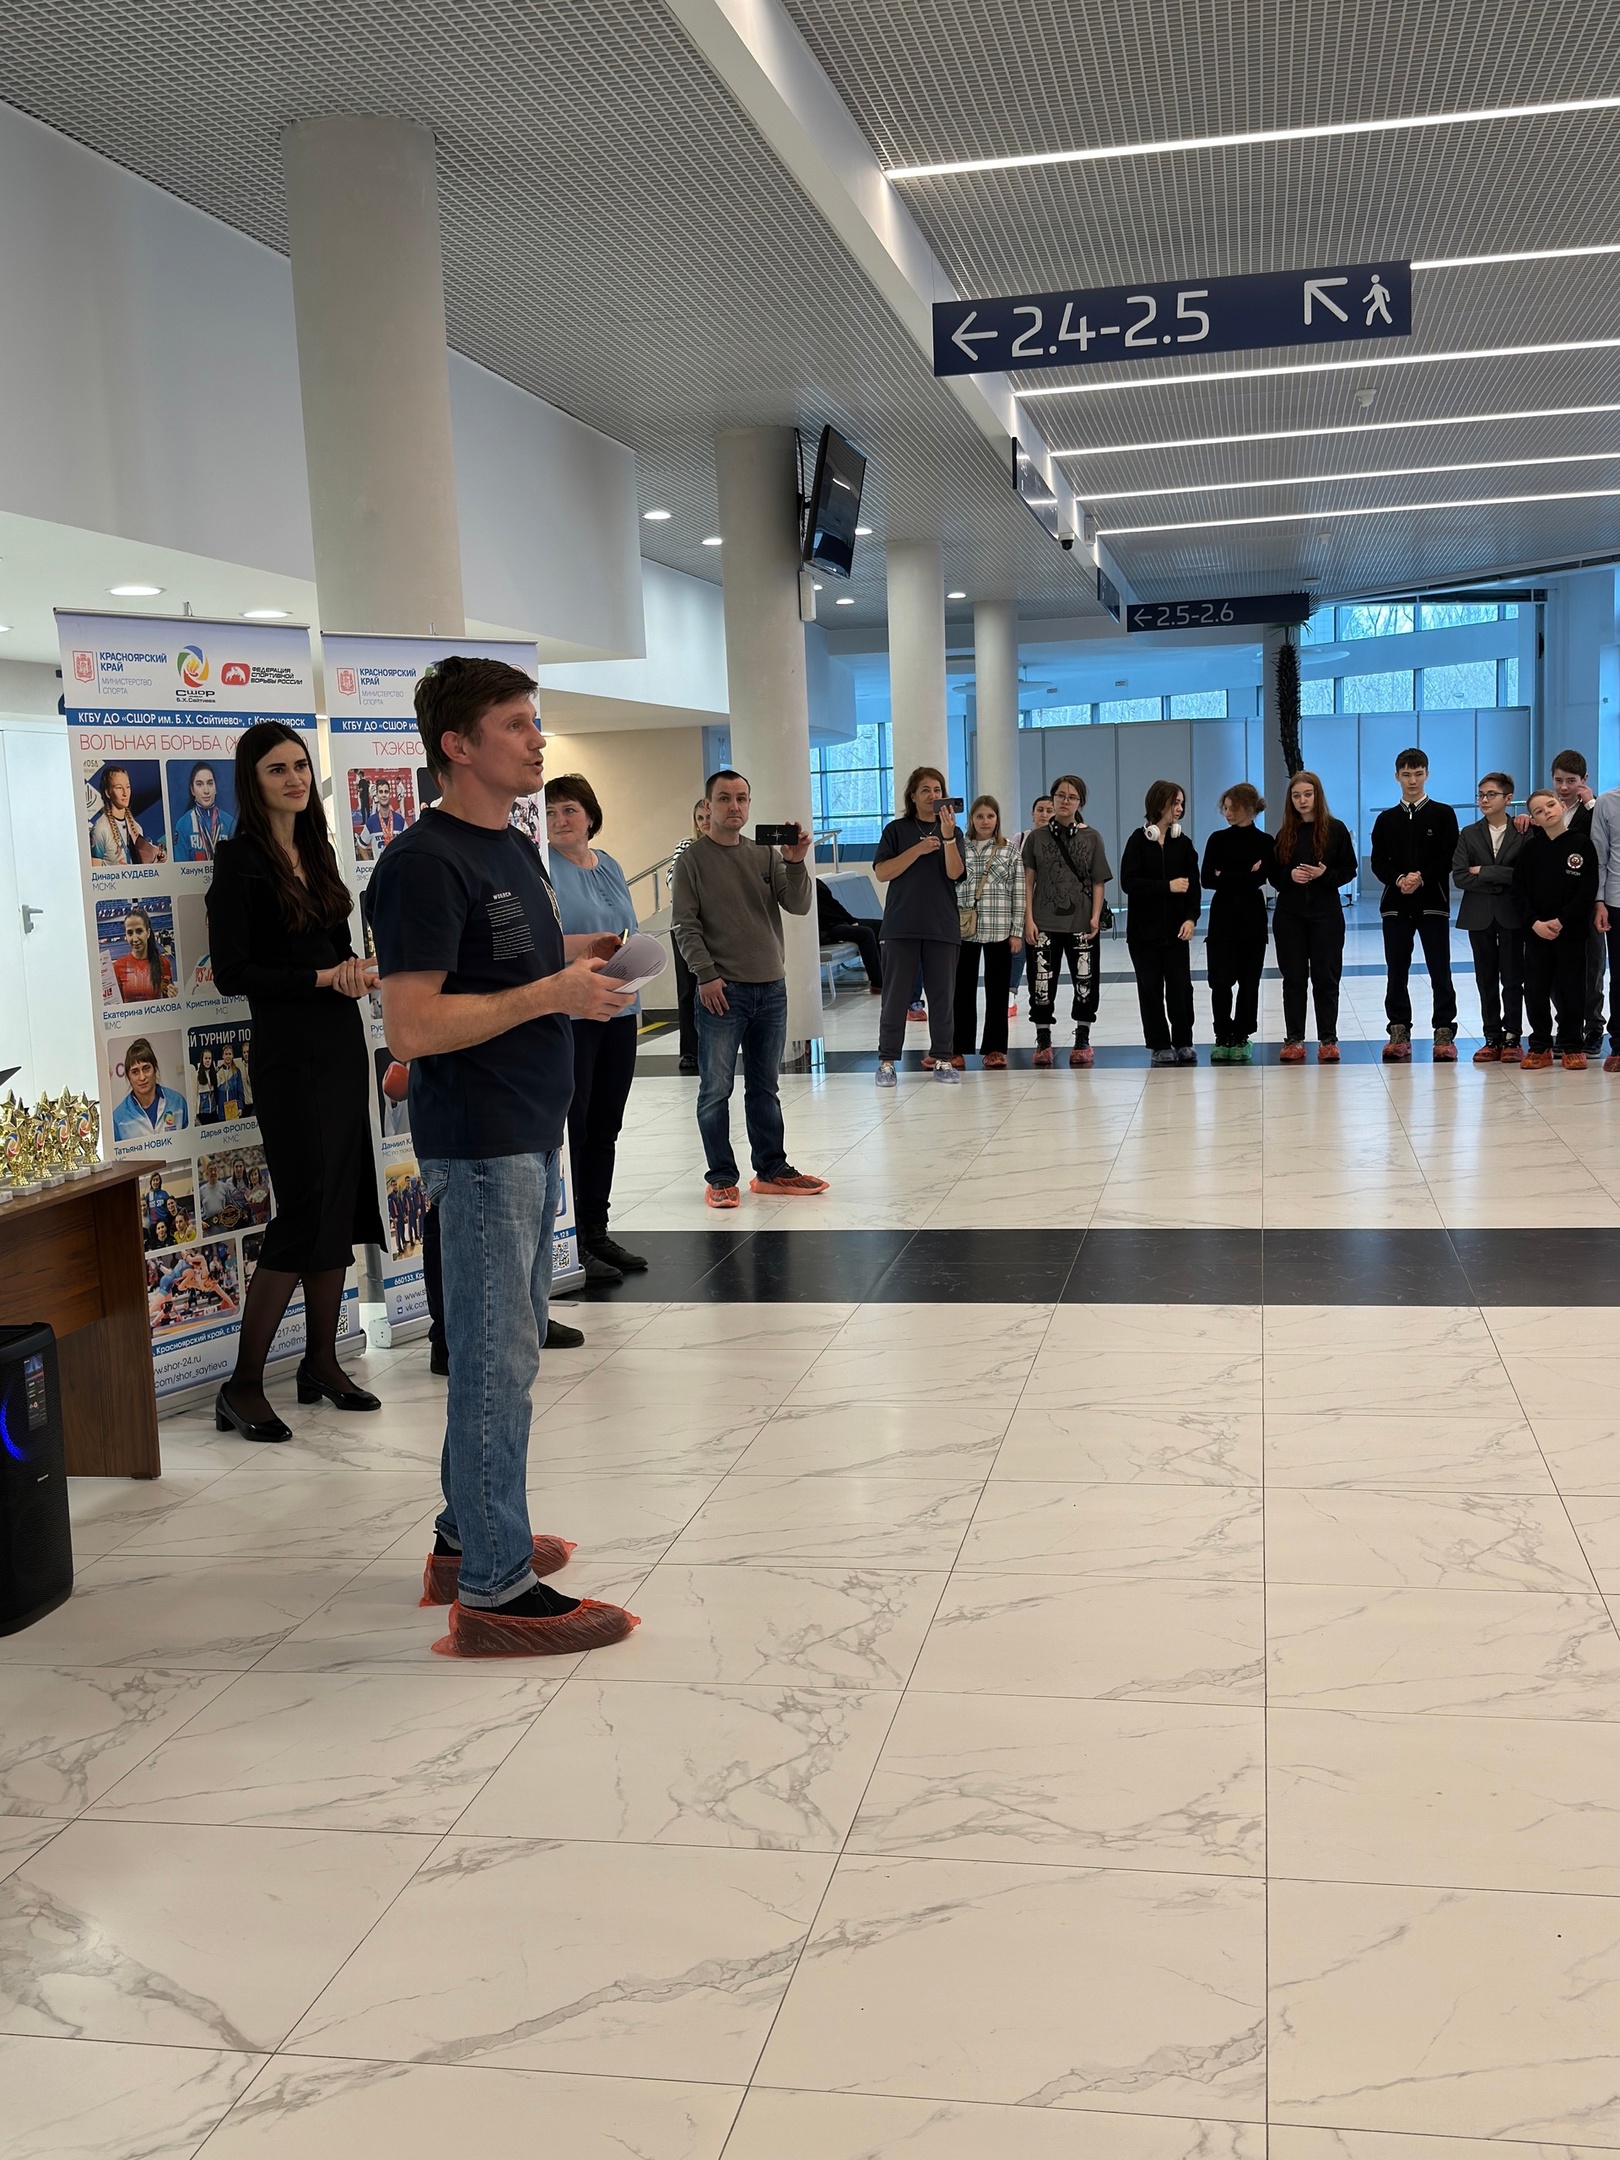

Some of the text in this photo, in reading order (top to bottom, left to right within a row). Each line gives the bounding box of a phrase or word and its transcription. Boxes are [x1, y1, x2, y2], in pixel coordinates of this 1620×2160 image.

[1011, 290, 1210, 357] 2.4-2.5
[1156, 602, 1234, 626] 2.5-2.6
[99, 652, 167, 663] КРАСНОЯРСКИЙ
[100, 662, 124, 672] КРАЙ
[359, 667, 417, 677] КРАСНОЯРСКИЙ
[101, 678, 153, 686] МИНИСТЕРСТВО
[360, 677, 380, 686] КРАЙ
[102, 687, 129, 695] СПОРТА
[361, 690, 404, 698] МИНИСТЕРСТВО
[362, 698, 384, 706] СПОРТА
[78, 712, 101, 723] КГБУ
[103, 713, 120, 725] ДО
[158, 715, 174, 724] им.
[342, 720, 363, 731] КГБУ
[363, 721, 378, 732] ДО
[80, 734, 157, 751] ВОЛЬНАЯ
[161, 735, 222, 751] БОРЬБА
[372, 741, 426, 756] ТХЭКВО
[91, 869, 160, 881] Динара КУДАЕВА
[180, 866, 204, 877] Ханум
[92, 882, 117, 891] МСМК
[186, 998, 221, 1009] Кристина
[102, 1003, 182, 1020] Екатерина ИСАКОВА
[199, 1030, 237, 1046] ТУРНИР
[200, 1129, 222, 1140] Дарья
[114, 1137, 173, 1156] Татьяна НОВИК
[156, 1333, 207, 1355] Красноярский
